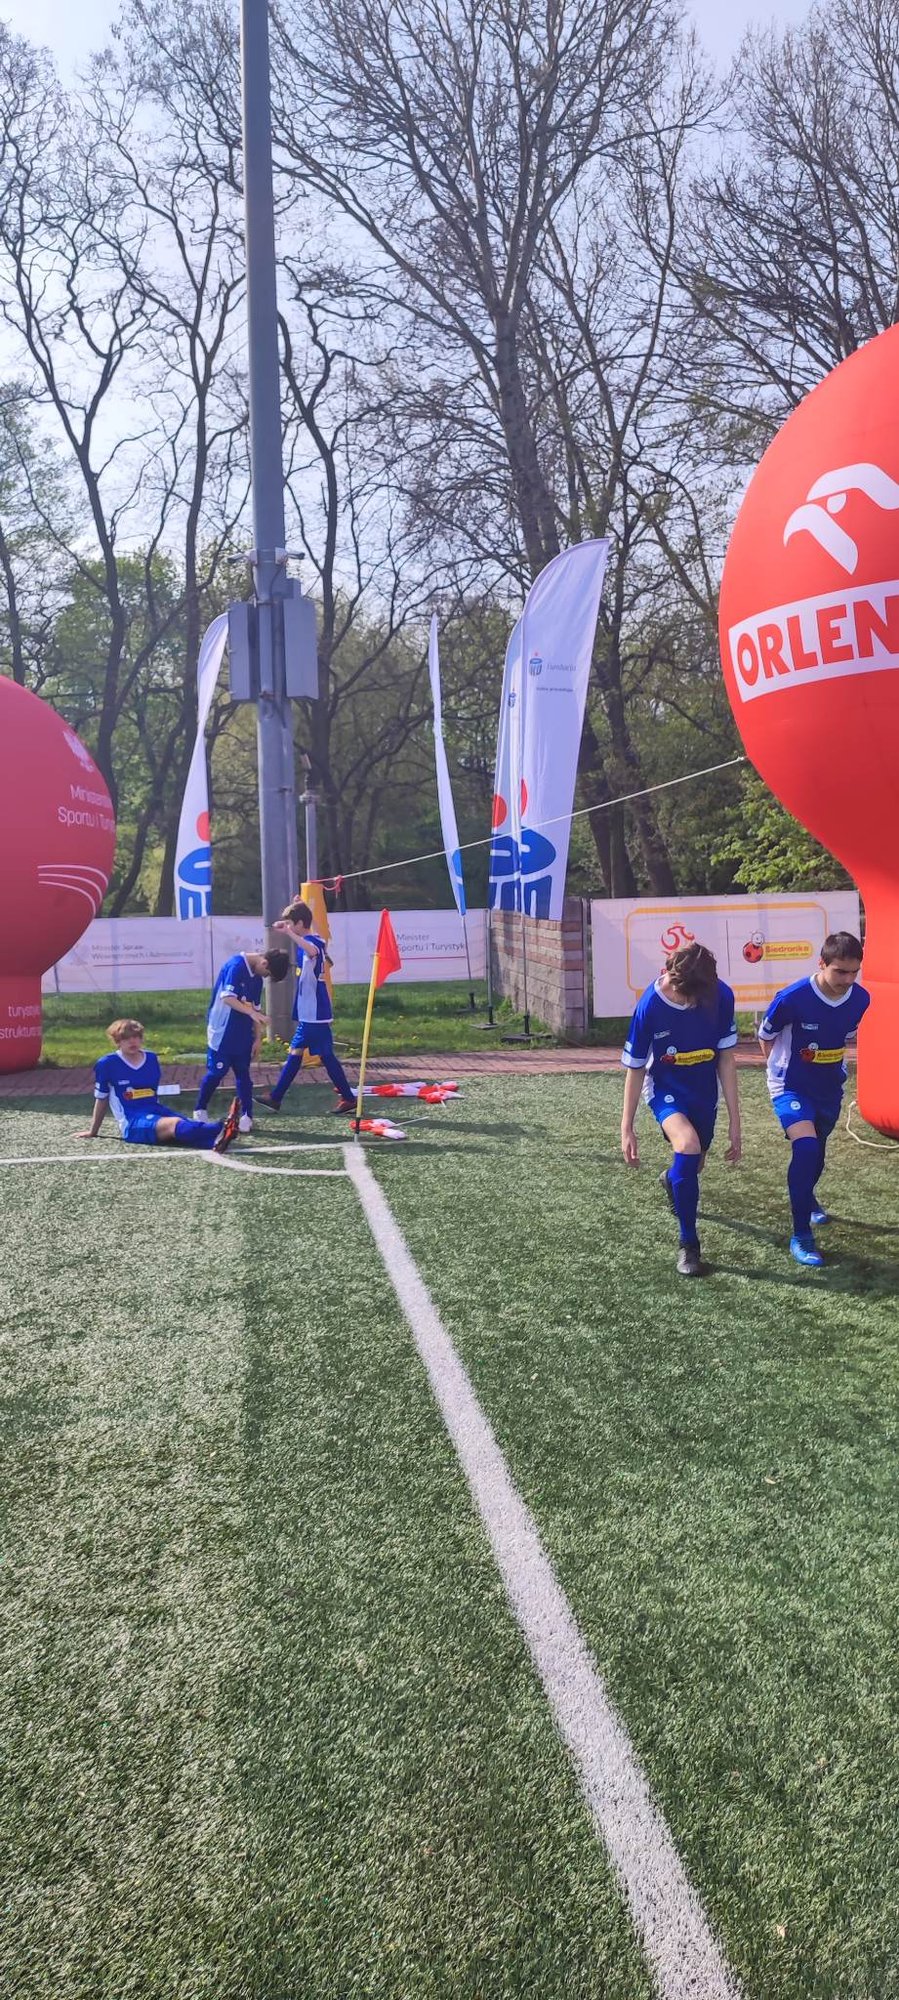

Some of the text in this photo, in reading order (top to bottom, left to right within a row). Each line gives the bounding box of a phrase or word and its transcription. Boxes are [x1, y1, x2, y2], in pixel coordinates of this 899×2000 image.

[737, 595, 899, 686] ORLEN
[58, 806, 95, 828] Sportu
[432, 942, 465, 951] Turystyk
[765, 945, 809, 953] Biedronka
